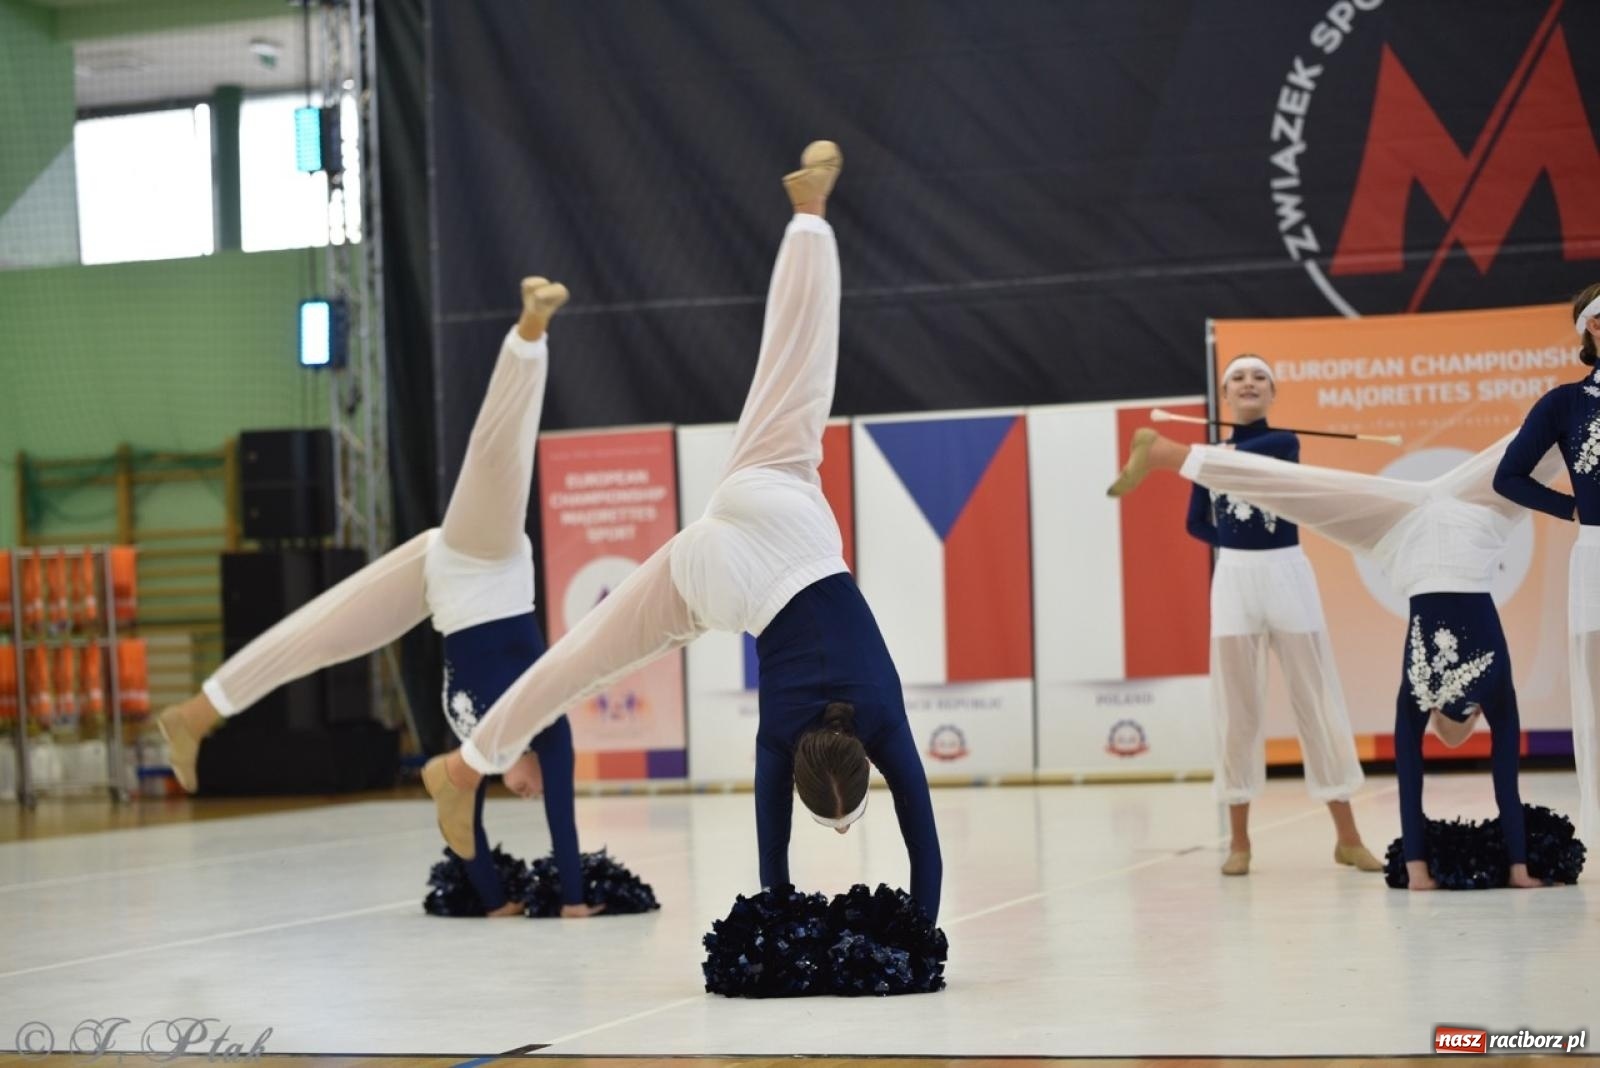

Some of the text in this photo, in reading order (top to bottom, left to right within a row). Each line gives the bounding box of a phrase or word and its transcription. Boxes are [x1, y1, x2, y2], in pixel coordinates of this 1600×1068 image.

[1273, 346, 1583, 383] EUROPEAN CHAMPIONSH
[1317, 375, 1557, 411] MAJORETTES SPORT
